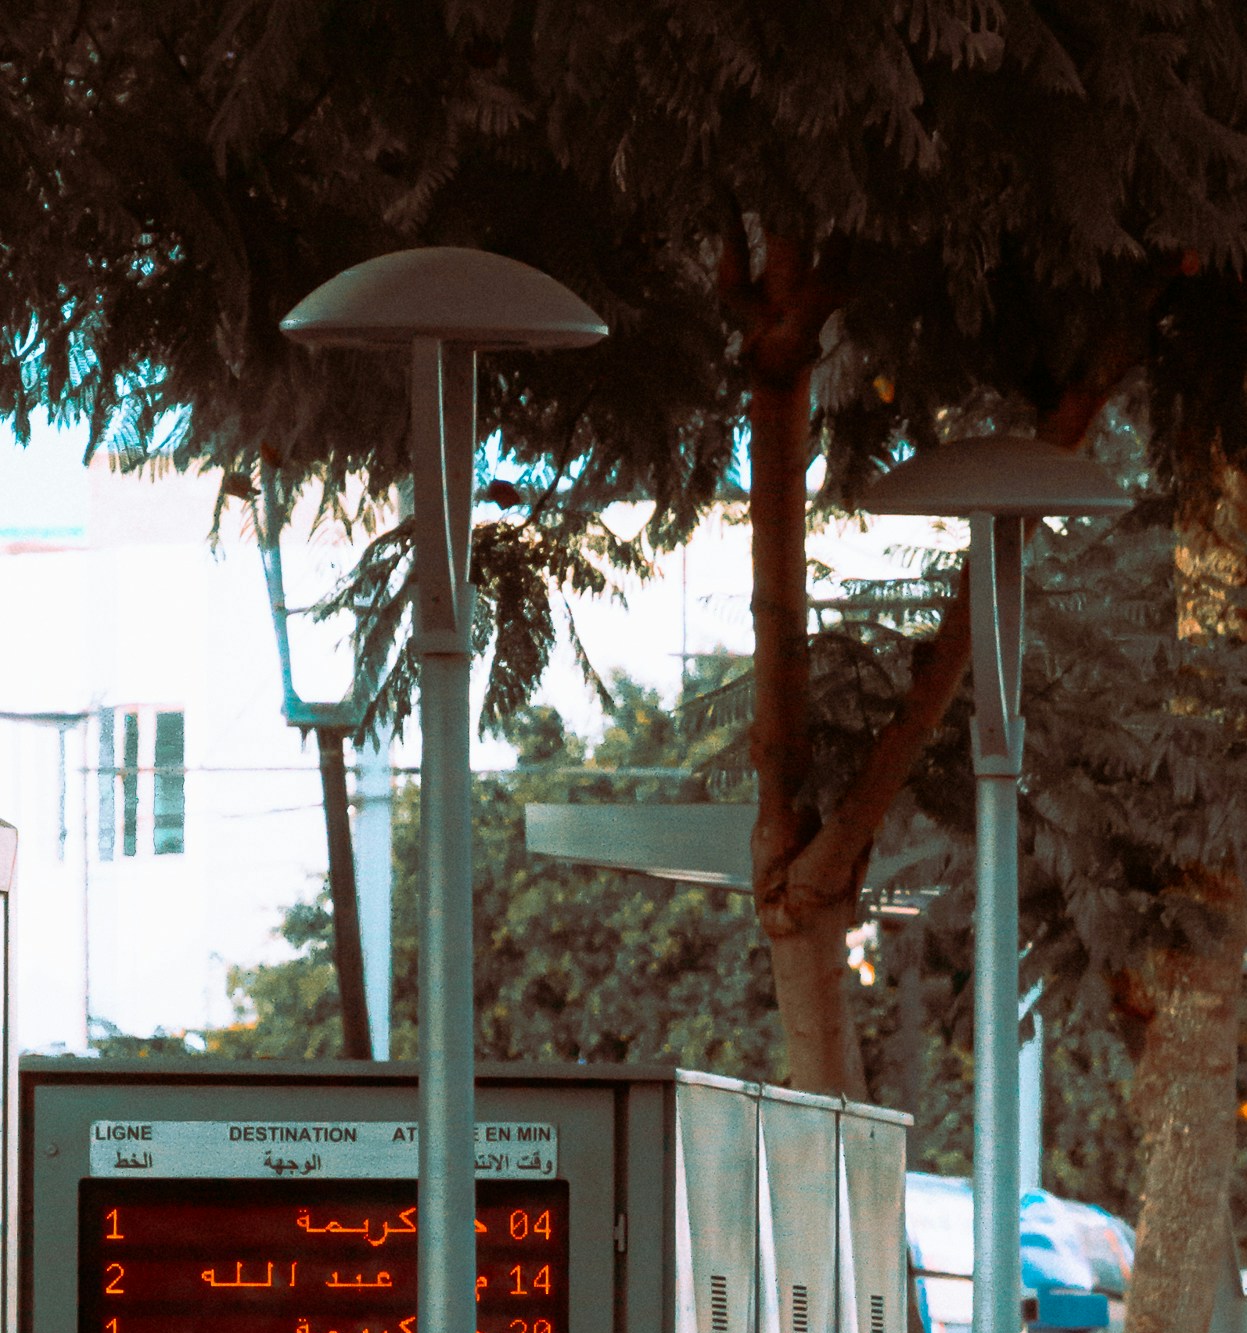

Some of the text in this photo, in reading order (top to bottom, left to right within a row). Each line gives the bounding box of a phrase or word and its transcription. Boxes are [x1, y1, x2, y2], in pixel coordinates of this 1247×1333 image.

[95, 1125, 152, 1141] LIGNE
[229, 1126, 357, 1142] DESTINATION
[486, 1126, 511, 1142] EN
[517, 1126, 551, 1142] MIN
[114, 1151, 153, 1169] الخط
[263, 1151, 321, 1176] الوجهة
[516, 1151, 553, 1175] وقت
[106, 1208, 125, 1239] 1
[296, 1207, 417, 1247] كريمة
[509, 1209, 552, 1241] 04
[106, 1263, 125, 1294] 2
[201, 1261, 298, 1288] الله
[326, 1271, 393, 1292] عبد
[509, 1264, 552, 1295] 14
